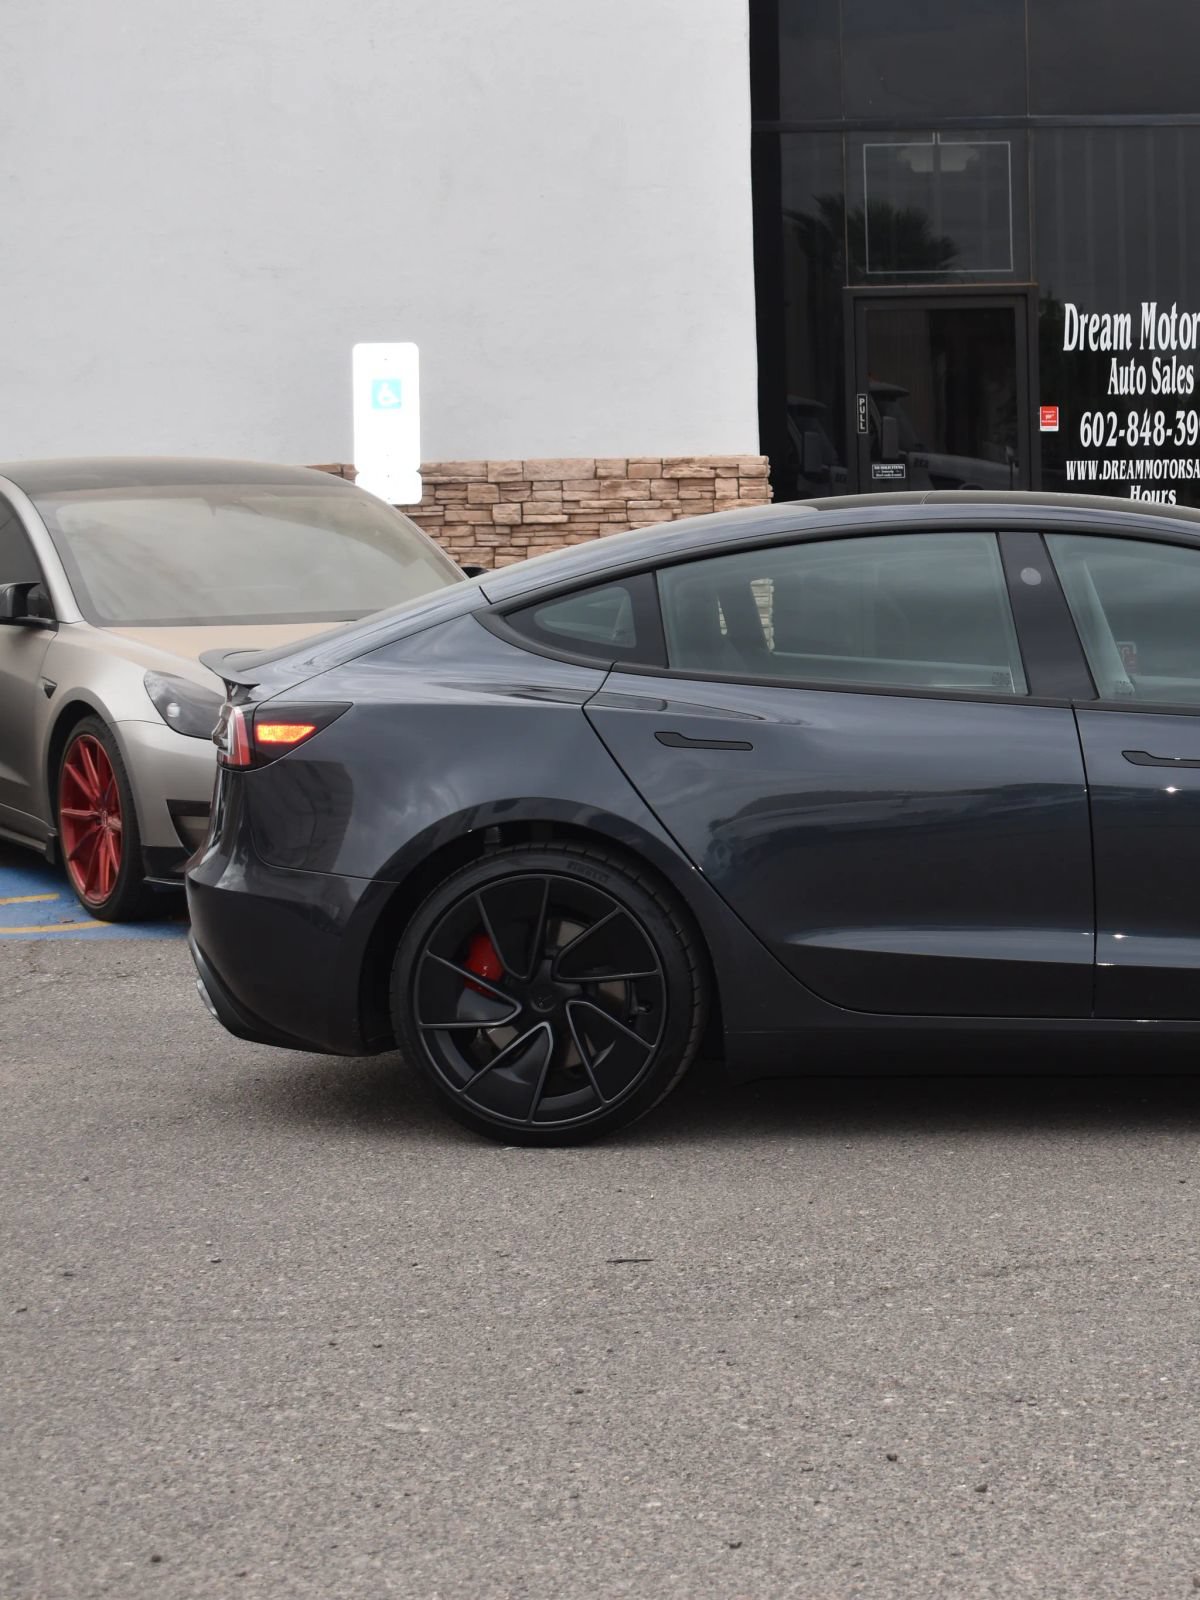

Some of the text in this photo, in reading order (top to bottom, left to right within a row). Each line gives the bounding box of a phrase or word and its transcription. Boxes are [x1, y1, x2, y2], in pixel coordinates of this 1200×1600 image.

[1063, 303, 1132, 351] Dream
[1107, 355, 1194, 395] Auto Sales
[1130, 485, 1177, 505] Hours
